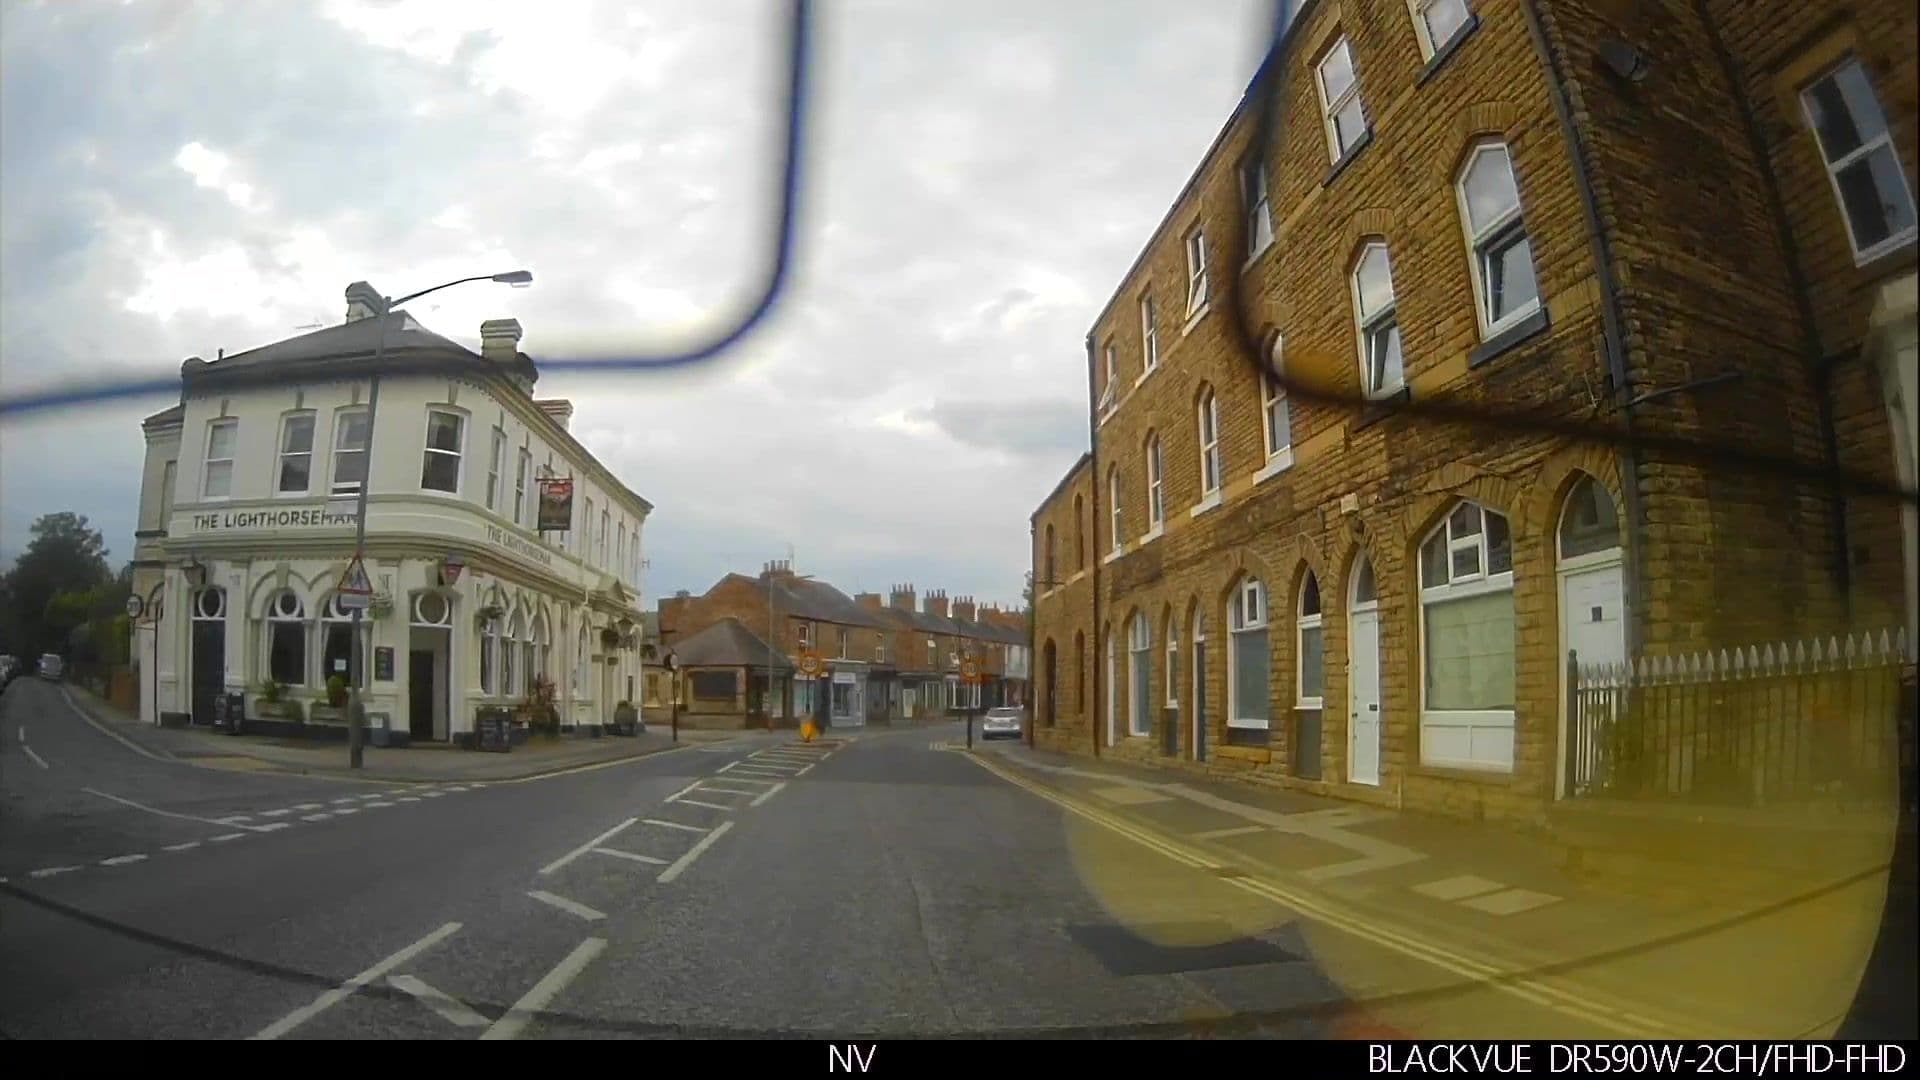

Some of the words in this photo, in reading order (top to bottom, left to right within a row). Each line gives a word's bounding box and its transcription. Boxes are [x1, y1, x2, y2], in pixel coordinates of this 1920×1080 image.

[193, 514, 218, 529] THE
[224, 510, 358, 528] LIGHTHORSEMAN
[487, 524, 503, 544] THE
